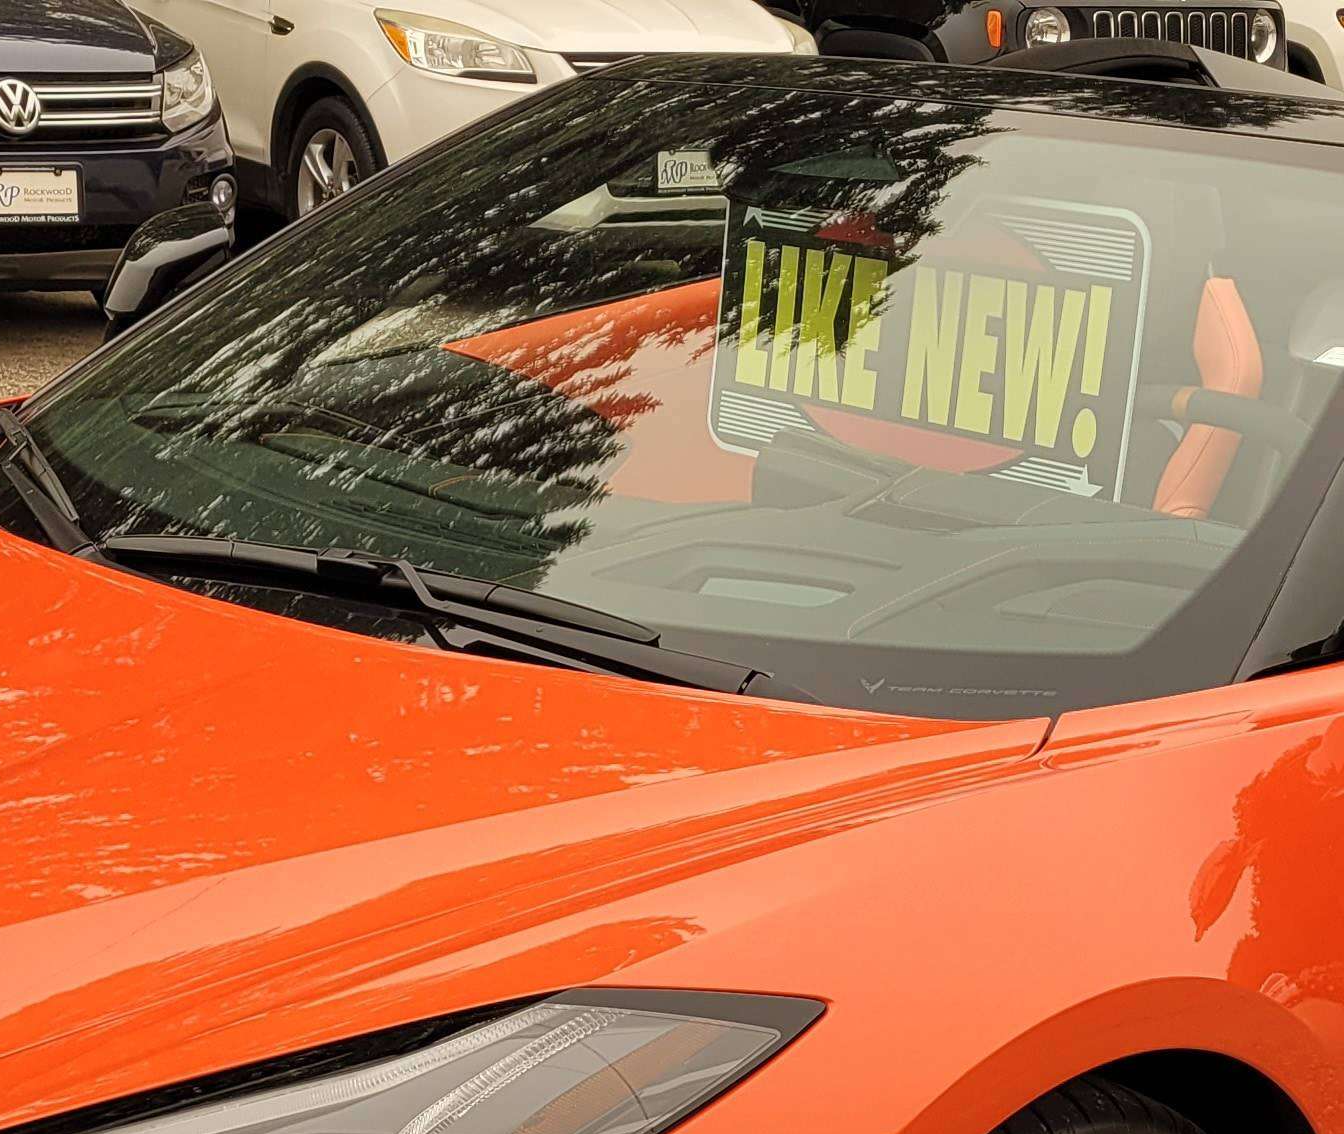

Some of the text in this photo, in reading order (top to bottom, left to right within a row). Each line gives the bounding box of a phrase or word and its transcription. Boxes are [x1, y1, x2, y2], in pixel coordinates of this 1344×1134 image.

[23, 187, 73, 196] ROCKWOOD
[21, 215, 47, 223] MOTOR
[47, 214, 80, 223] PRODUCTS
[735, 239, 1113, 458] LIKE NEW!
[949, 687, 1057, 697] CORVETTE
